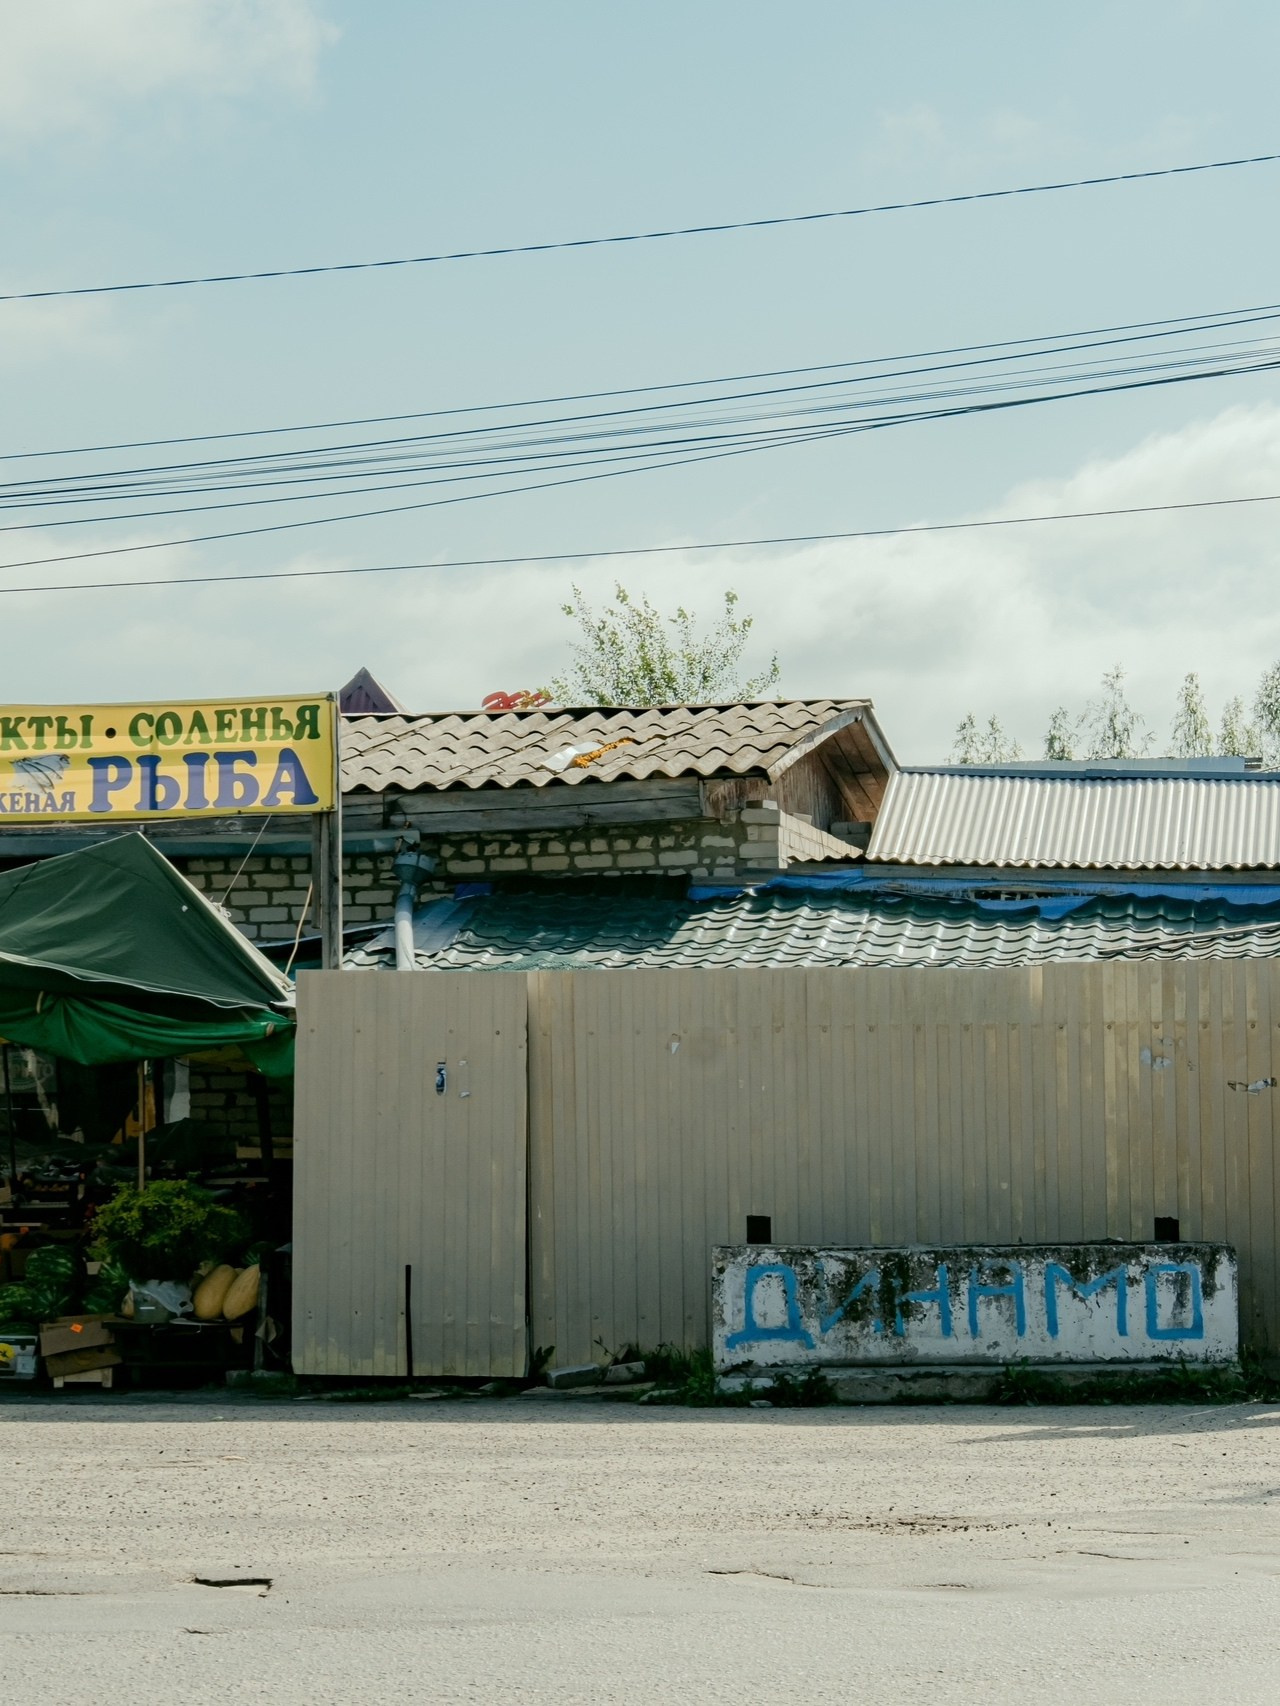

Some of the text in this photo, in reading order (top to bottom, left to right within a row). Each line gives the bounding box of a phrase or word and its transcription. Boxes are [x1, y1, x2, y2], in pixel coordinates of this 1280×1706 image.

[129, 704, 321, 749] СОЛЕНЬЯ
[87, 747, 320, 813] РЫБА
[725, 1261, 1205, 1350] ДИНАМО
